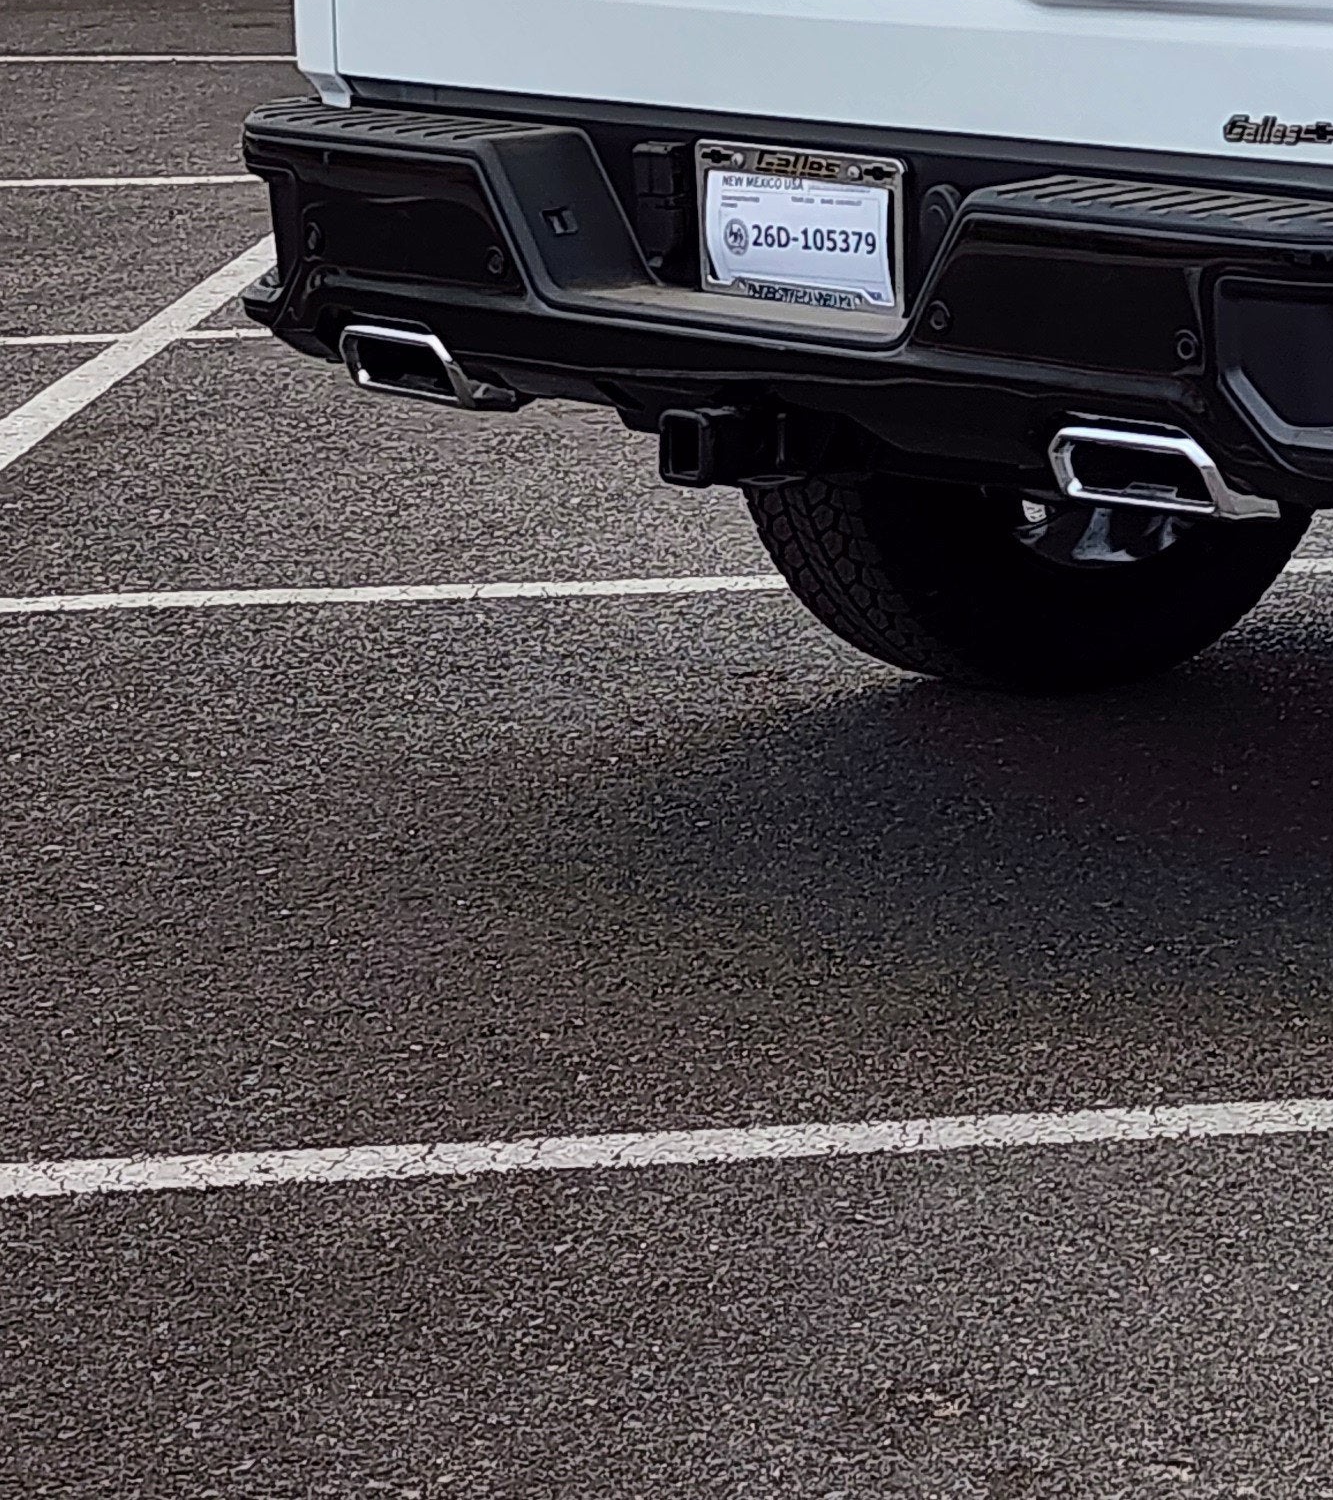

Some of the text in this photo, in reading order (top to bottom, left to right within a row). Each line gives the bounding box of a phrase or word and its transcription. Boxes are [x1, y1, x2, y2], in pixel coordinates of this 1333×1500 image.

[721, 175, 744, 187] NEW
[746, 176, 782, 190] MEXICO
[751, 224, 877, 255] 26D-105379
